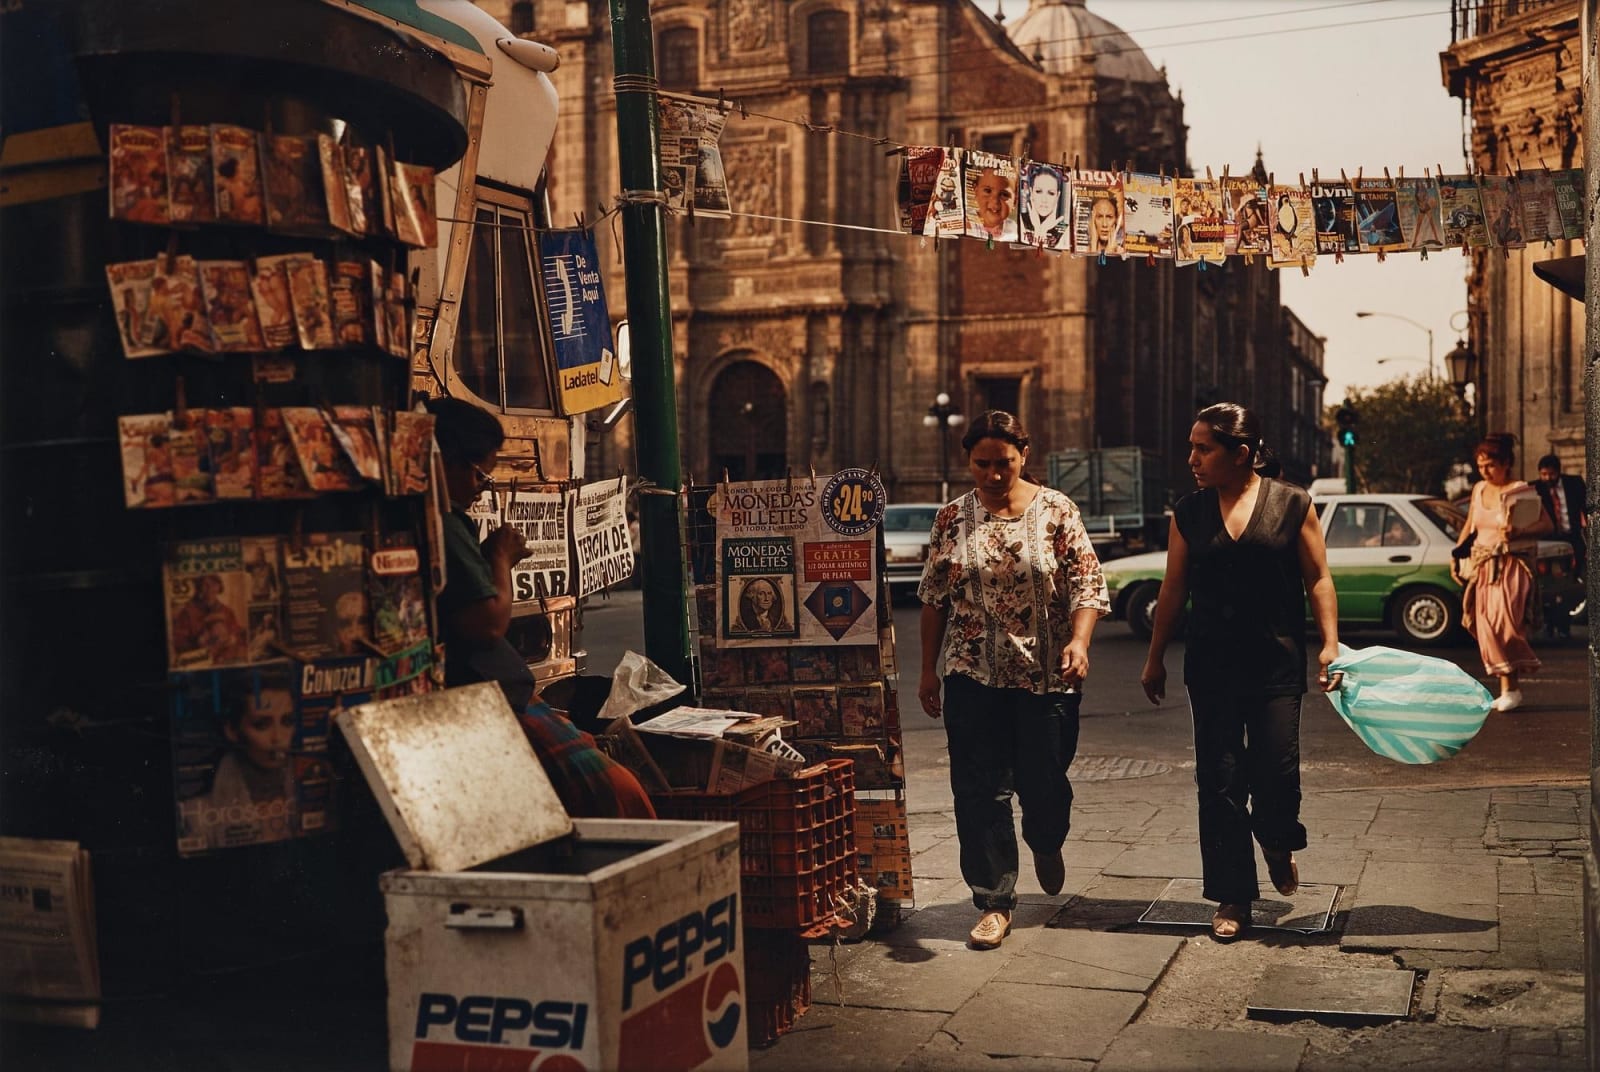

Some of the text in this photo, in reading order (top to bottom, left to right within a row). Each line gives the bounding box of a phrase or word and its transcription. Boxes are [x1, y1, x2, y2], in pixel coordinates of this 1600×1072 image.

[575, 255, 586, 268] De
[578, 271, 600, 286] Venta
[582, 286, 599, 304] Aquí
[564, 367, 598, 390] Ladatel
[724, 491, 815, 510] MONEDAS
[731, 508, 808, 526] BILLETES
[578, 523, 629, 566] TERCIA DE
[727, 545, 792, 558] MONEDAS
[734, 556, 789, 568] BILLETES
[814, 550, 860, 560] GRATIS
[582, 552, 632, 595] EJECUCIONES
[832, 571, 852, 580] PLATA
[516, 570, 566, 600] SAR
[621, 892, 737, 1013] PEPSI
[415, 993, 588, 1050] PEPSI
